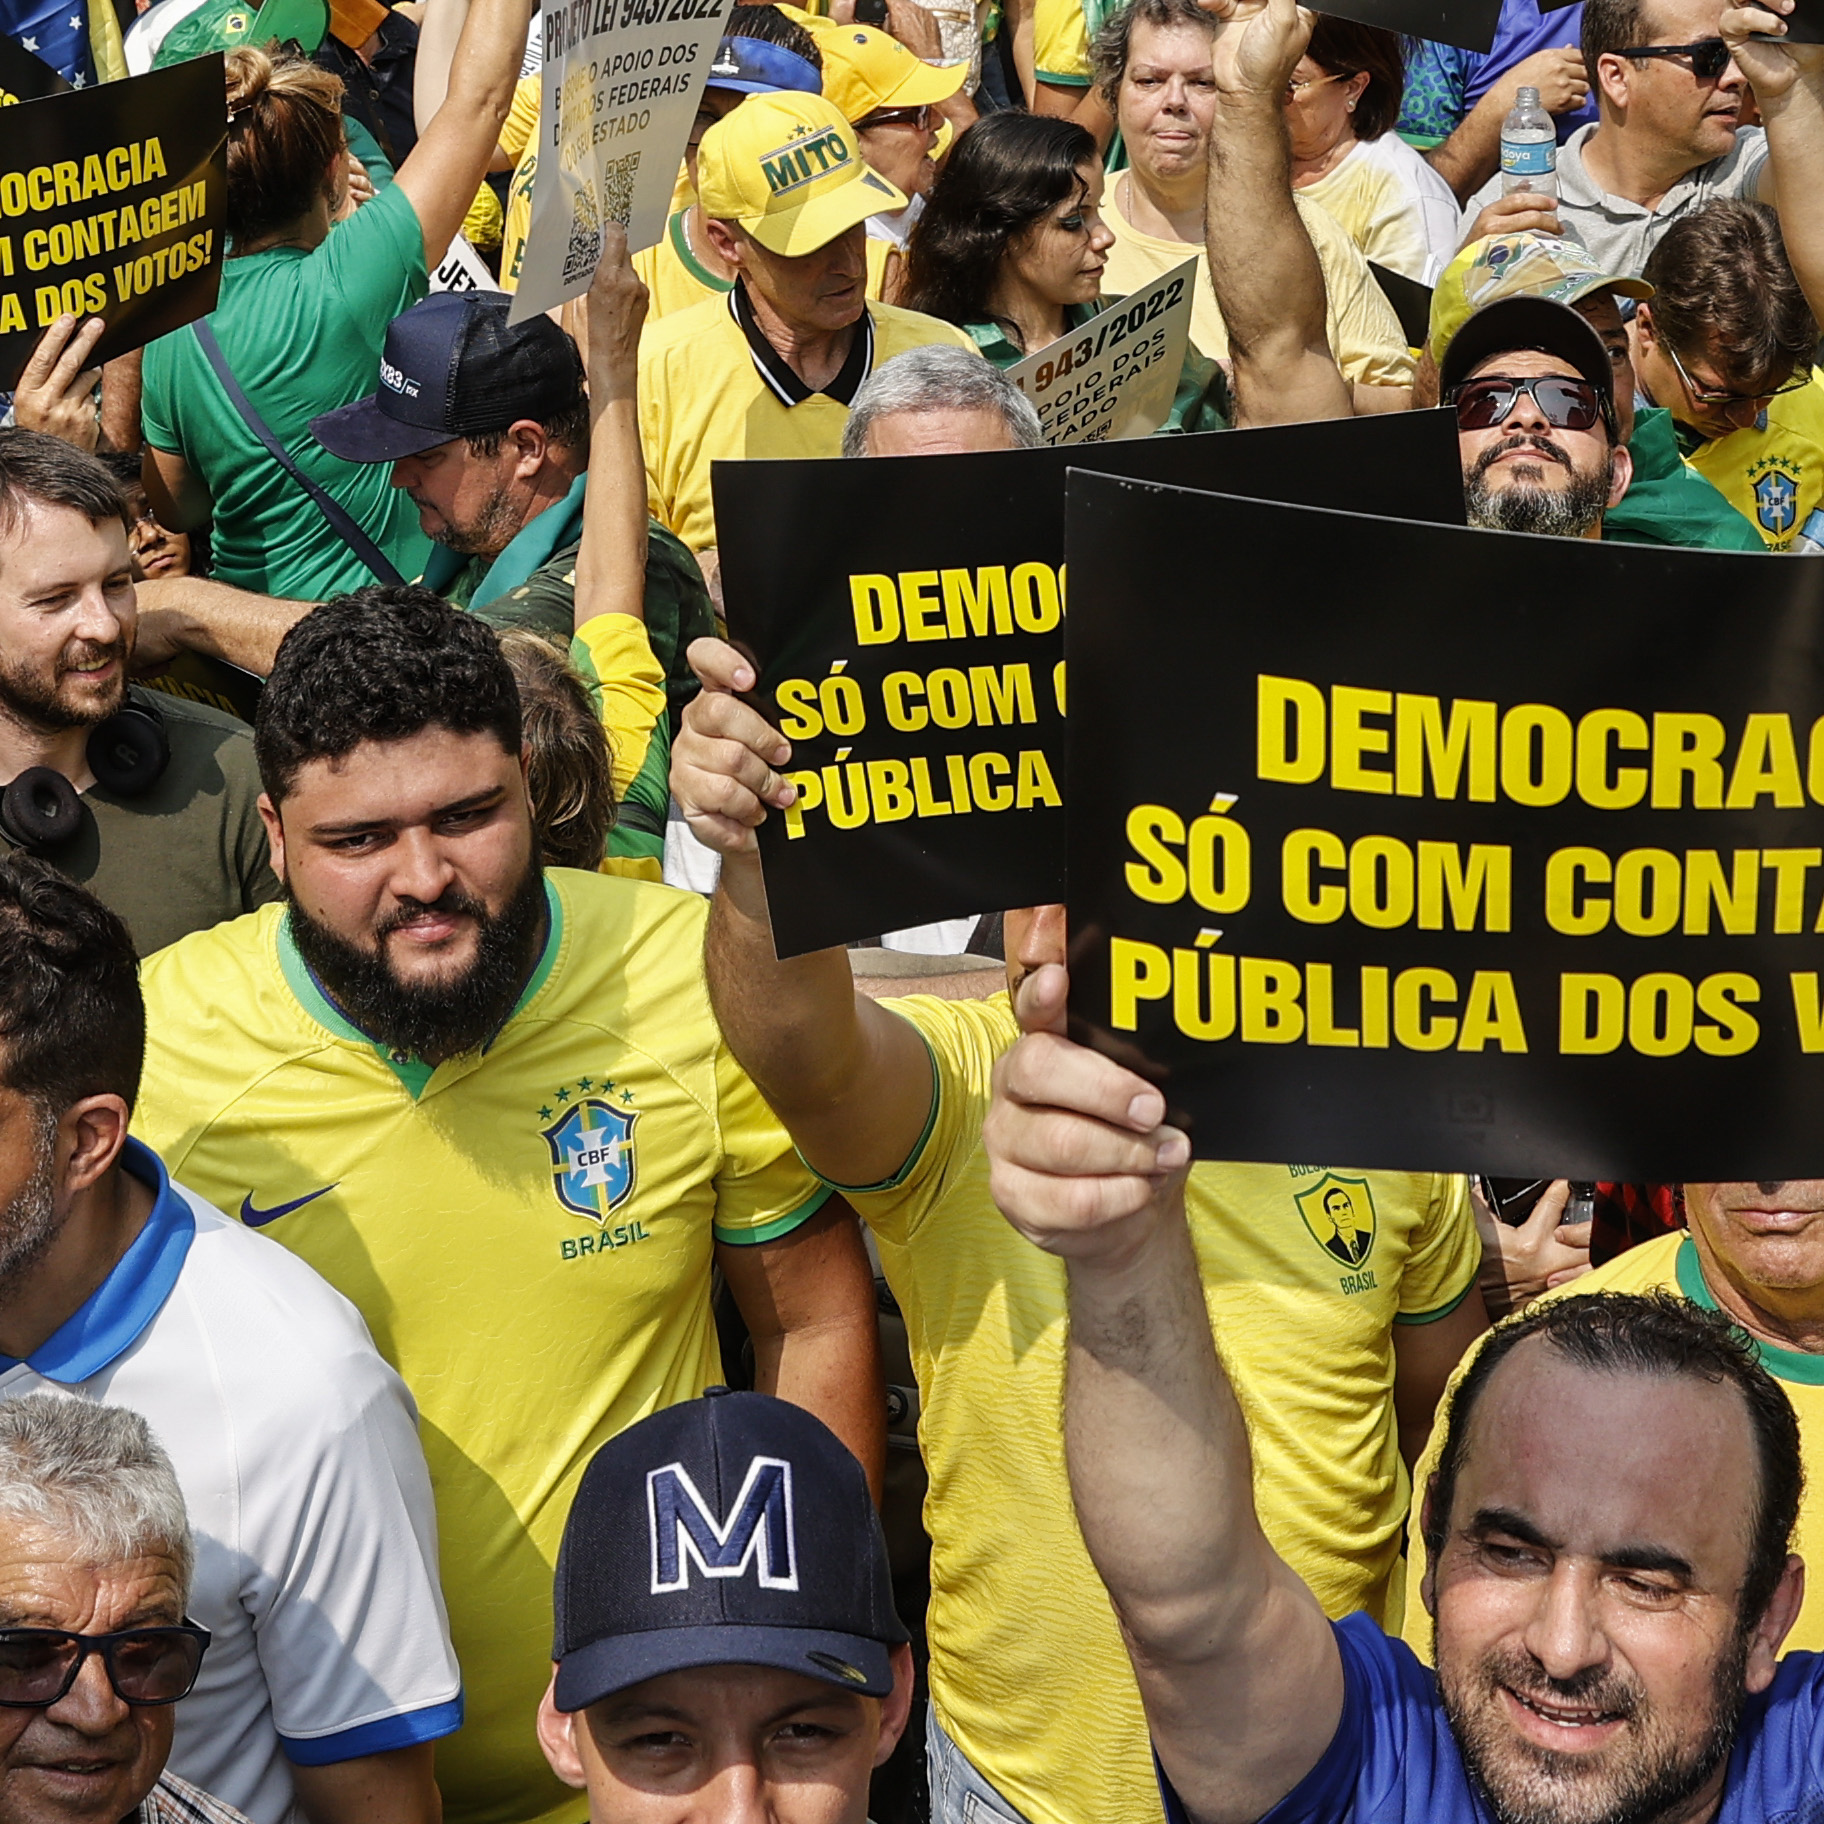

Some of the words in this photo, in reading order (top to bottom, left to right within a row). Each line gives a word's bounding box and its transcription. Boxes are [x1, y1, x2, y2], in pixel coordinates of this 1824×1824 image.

[600, 47, 655, 81] APOIO
[658, 42, 700, 65] DOS
[608, 72, 693, 109] FEDERAIS
[592, 109, 652, 146] ESTADO
[761, 131, 849, 194] MITO
[21, 180, 208, 269] CONTAGEM
[35, 266, 109, 330] DOS
[116, 227, 214, 307] VOTOS!
[1035, 278, 1184, 393] 943/2022
[1112, 328, 1165, 372] DOS
[1043, 345, 1166, 433] FEDERAIS
[777, 659, 867, 742] SÓ
[883, 659, 1038, 733] COM
[783, 747, 1064, 841] PÚBLICA
[1122, 792, 1253, 918] SÓ
[1280, 828, 1514, 936] COM
[1108, 926, 1531, 1057] PÚBLICA
[1556, 970, 1762, 1060] DOS
[577, 1147, 610, 1169] CBF
[559, 1219, 651, 1262] BRASIL
[1340, 1269, 1378, 1296] BRASIL
[644, 1454, 800, 1594] M
